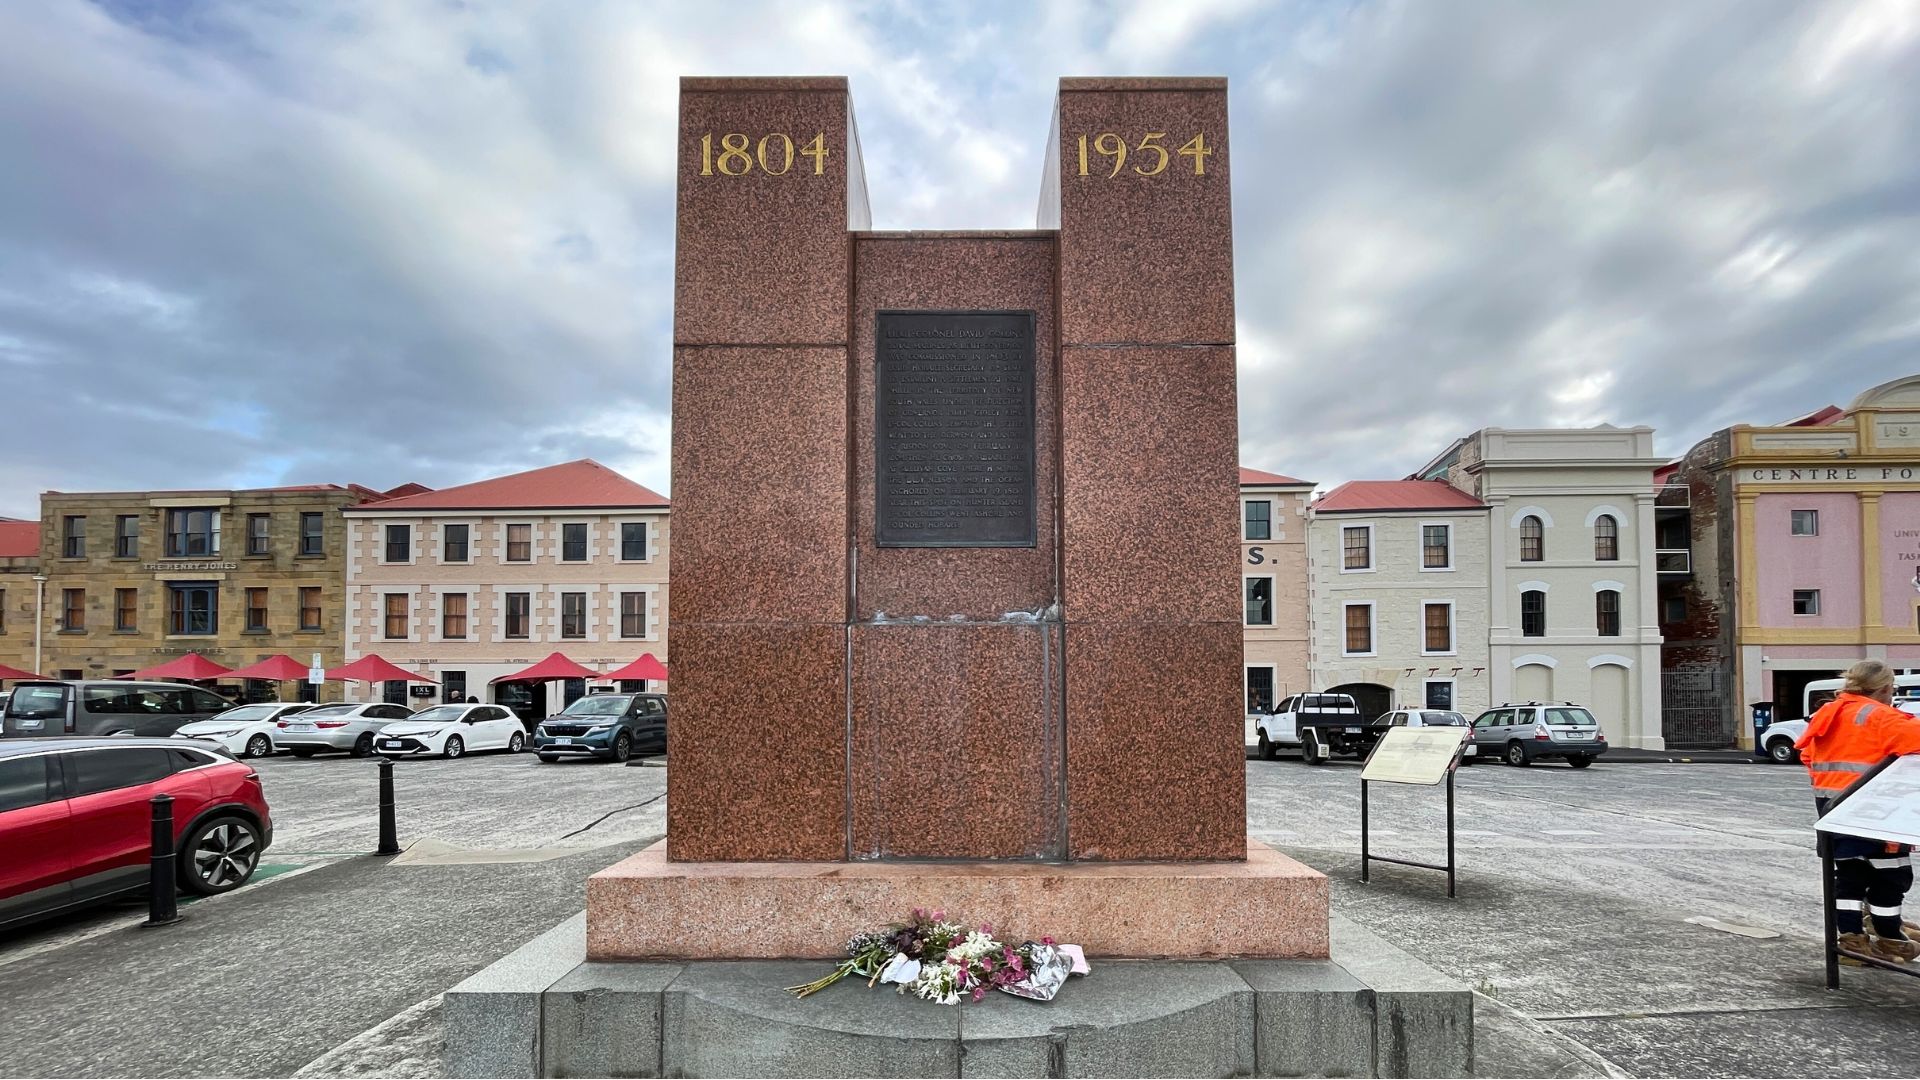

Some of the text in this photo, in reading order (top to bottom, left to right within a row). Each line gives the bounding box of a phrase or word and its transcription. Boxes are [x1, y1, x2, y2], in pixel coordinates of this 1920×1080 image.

[700, 132, 829, 176] 1804
[1078, 132, 1212, 179] 1954
[959, 328, 984, 338] DAVID
[1753, 468, 1913, 481] CENTRE FO
[143, 561, 237, 571] THE HENRY JONES
